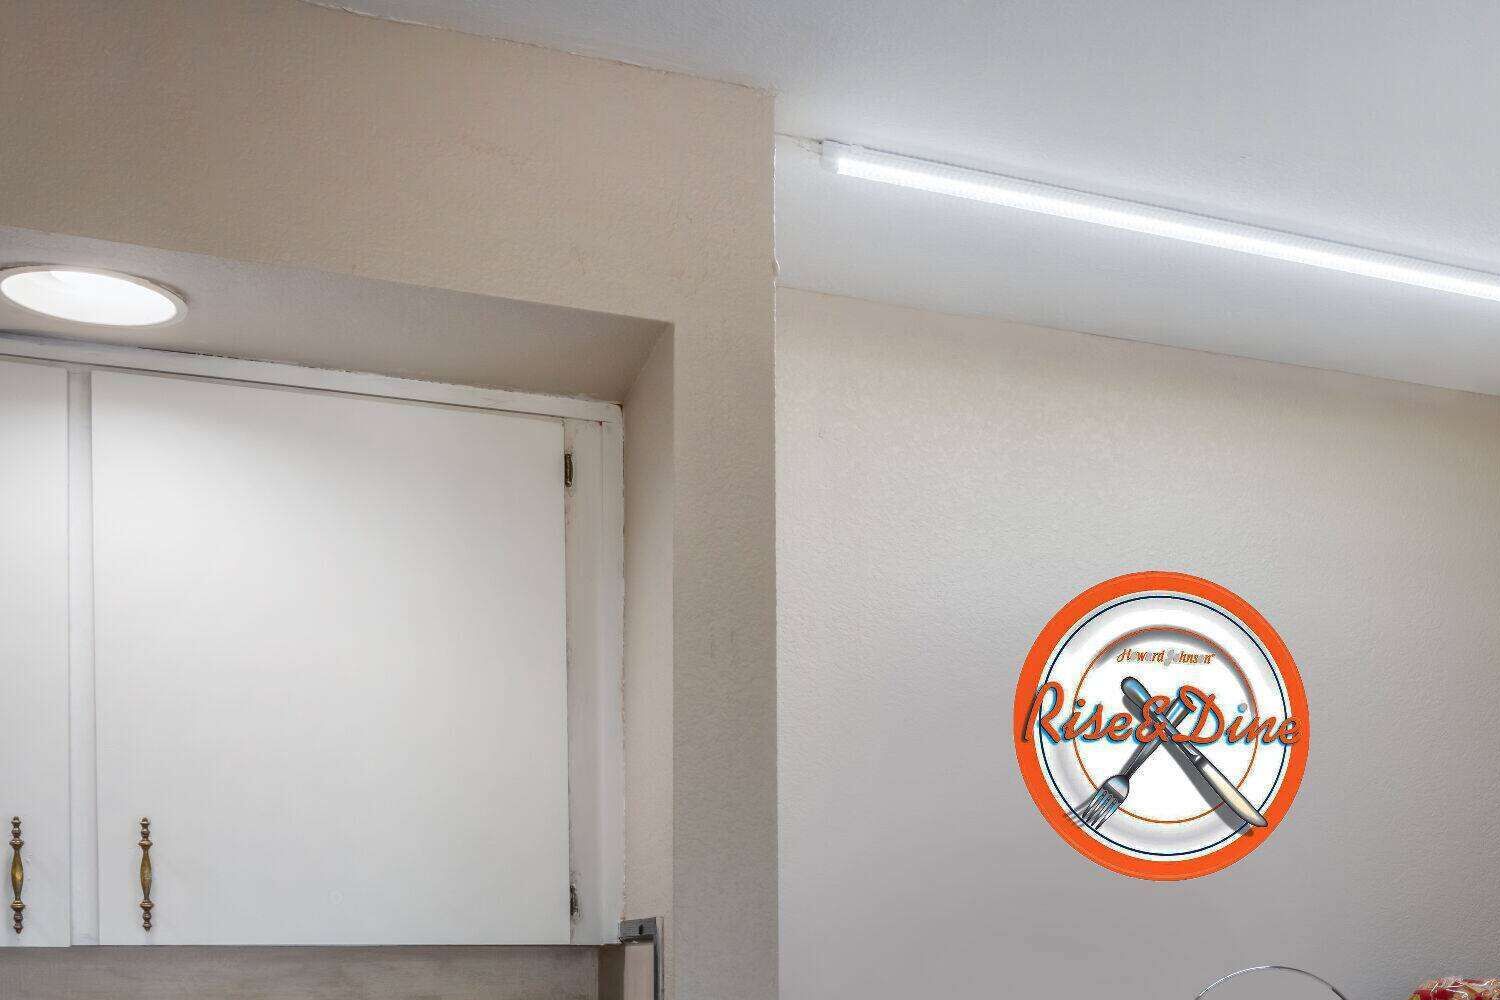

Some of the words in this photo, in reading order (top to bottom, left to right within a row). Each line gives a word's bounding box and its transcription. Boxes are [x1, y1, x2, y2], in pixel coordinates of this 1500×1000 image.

[1117, 648, 1165, 663] Howard
[1164, 648, 1211, 666] Johnson
[1023, 681, 1132, 744] Rise
[1174, 685, 1301, 745] Dine
